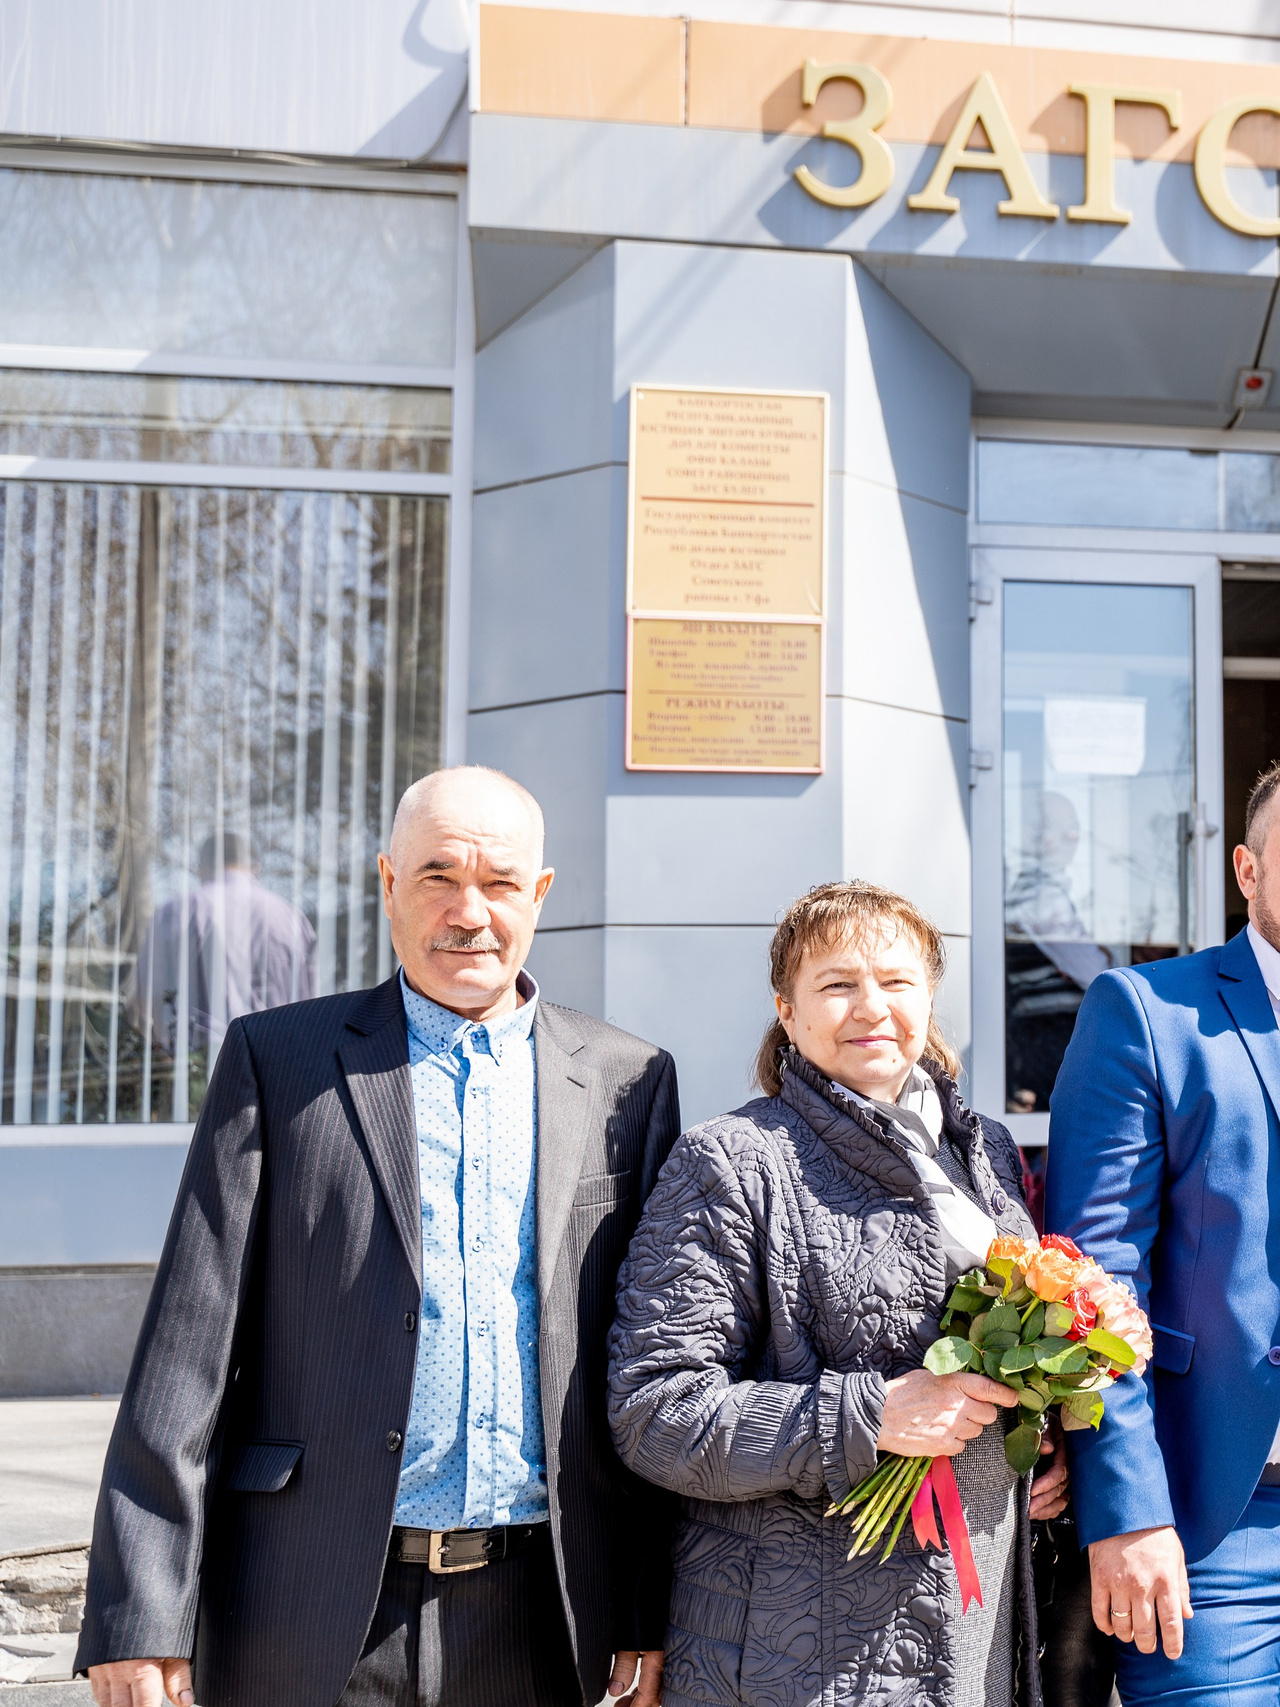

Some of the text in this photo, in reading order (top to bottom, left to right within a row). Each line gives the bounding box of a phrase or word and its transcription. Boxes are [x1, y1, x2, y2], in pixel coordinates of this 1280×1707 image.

[644, 508, 811, 525] Государственный комитет
[643, 524, 813, 542] Республики Башкортостан
[689, 558, 765, 571] Отдел ЗАГС
[691, 575, 764, 587] Советского
[683, 592, 731, 605] района
[665, 698, 722, 709] РЕЖИМ
